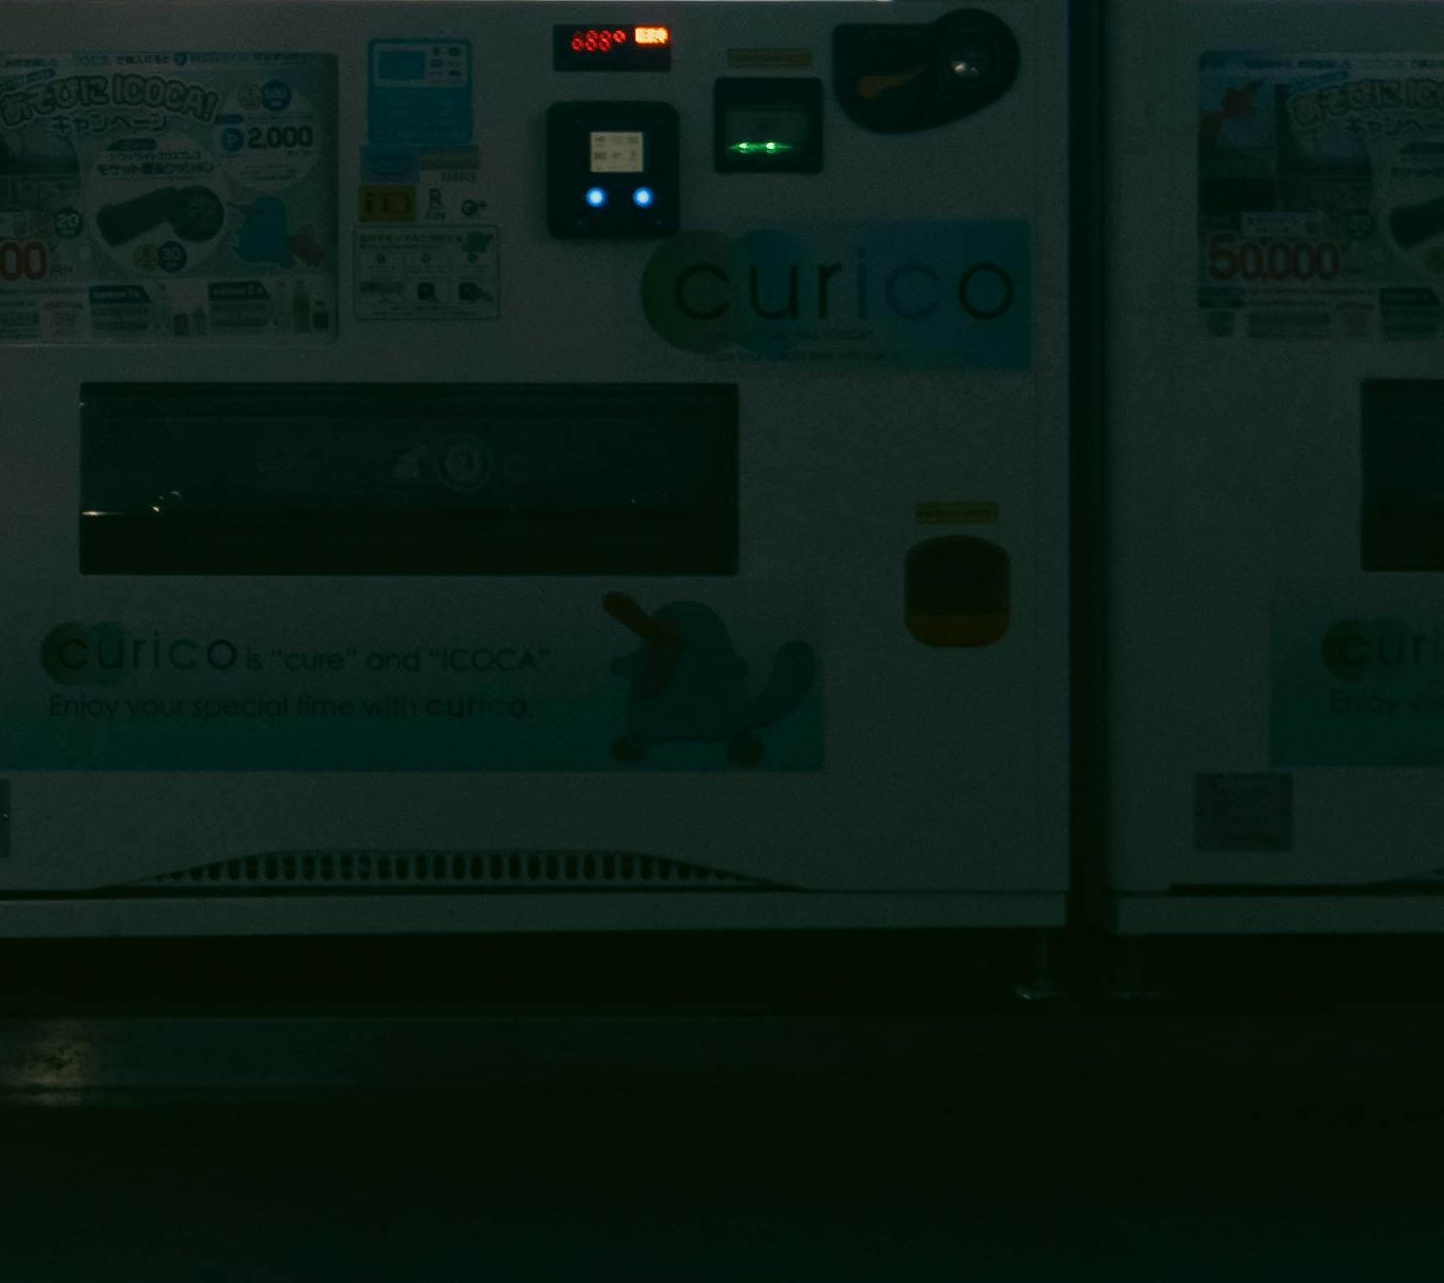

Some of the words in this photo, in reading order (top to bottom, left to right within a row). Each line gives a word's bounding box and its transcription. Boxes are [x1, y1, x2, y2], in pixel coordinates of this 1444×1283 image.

[112, 73, 221, 125] ICOCA!
[51, 113, 170, 136] キャンペーン
[247, 125, 314, 149] 2,000
[1208, 231, 1341, 283] 50,000
[676, 247, 1015, 321] curico
[57, 629, 238, 671] curico
[245, 647, 264, 671] is
[366, 647, 420, 671] and
[49, 693, 117, 724] Enjoy
[125, 700, 182, 724] your
[191, 693, 290, 724] special
[297, 693, 355, 718] time
[365, 693, 420, 718] with
